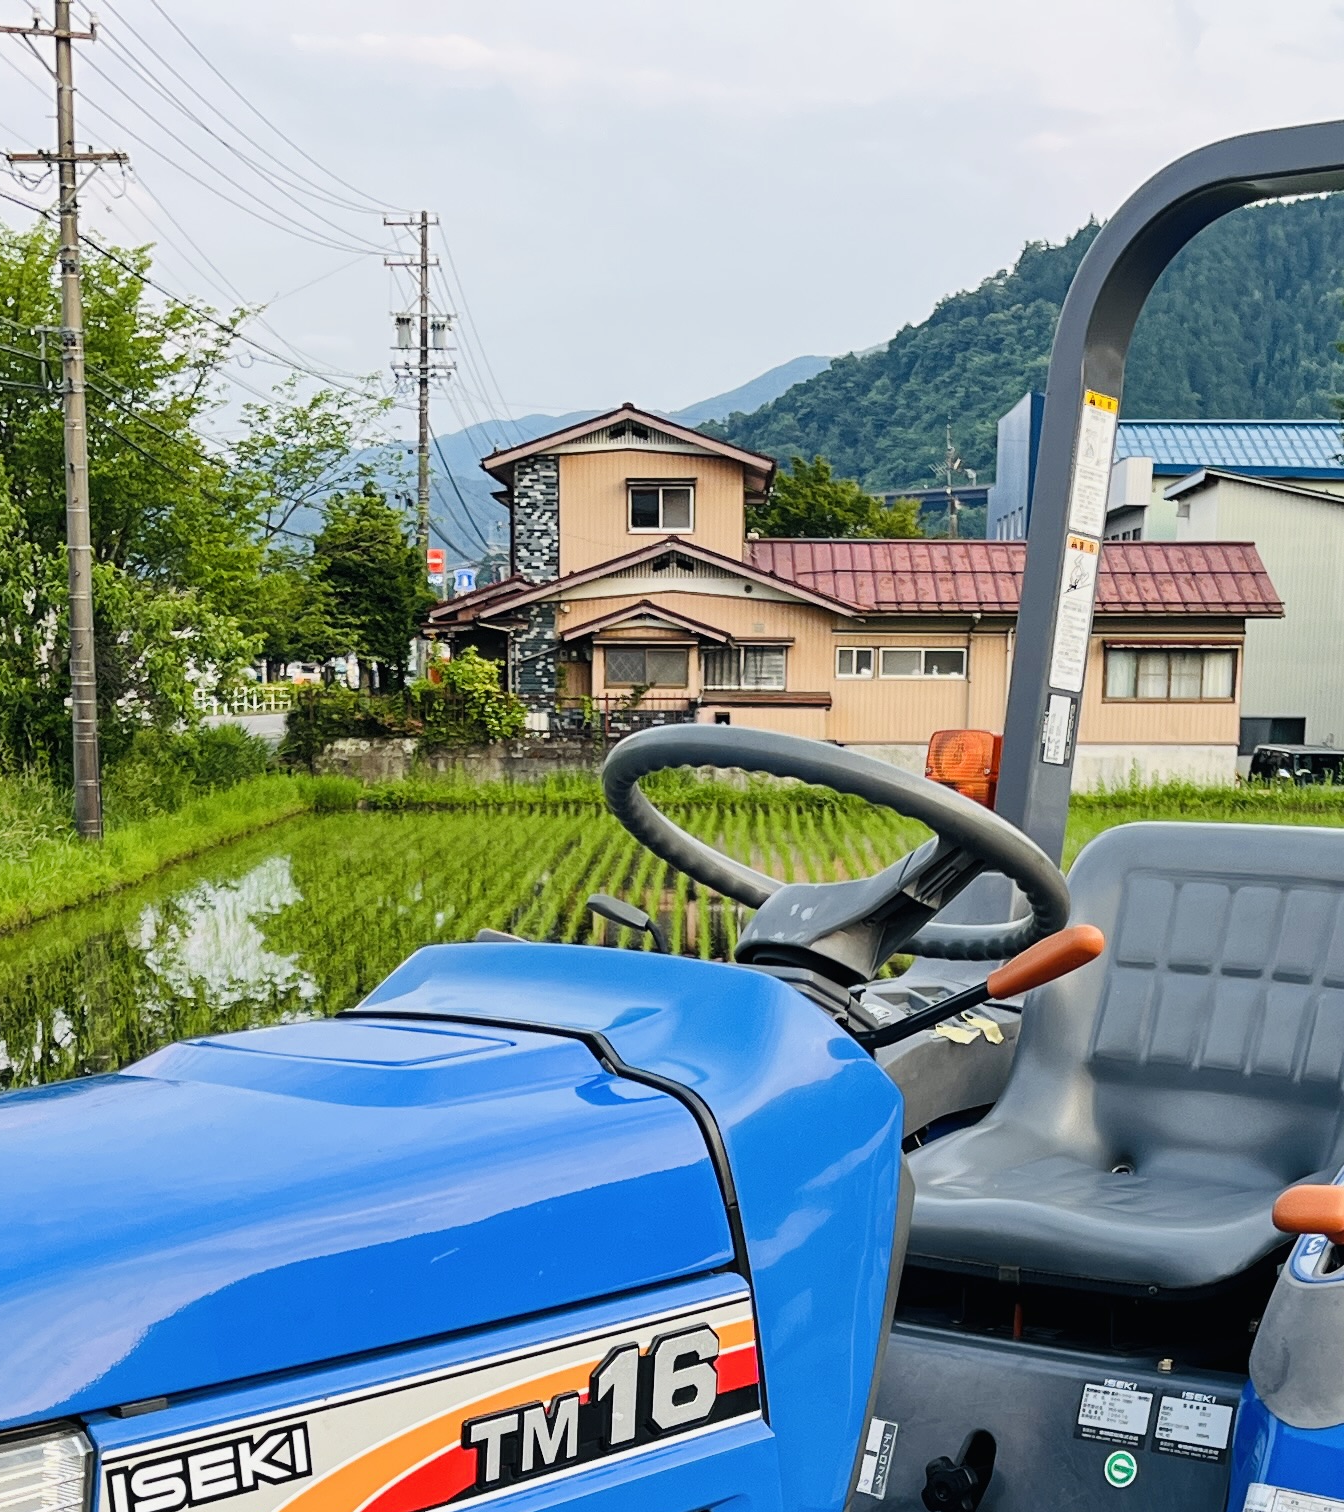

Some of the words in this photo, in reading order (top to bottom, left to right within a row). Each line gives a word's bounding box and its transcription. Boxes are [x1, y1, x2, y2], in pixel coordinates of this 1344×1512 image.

[1103, 1378, 1138, 1391] ISEKI
[1181, 1391, 1217, 1404] ISEKI
[464, 1393, 582, 1487] TM
[589, 1323, 721, 1449] 16
